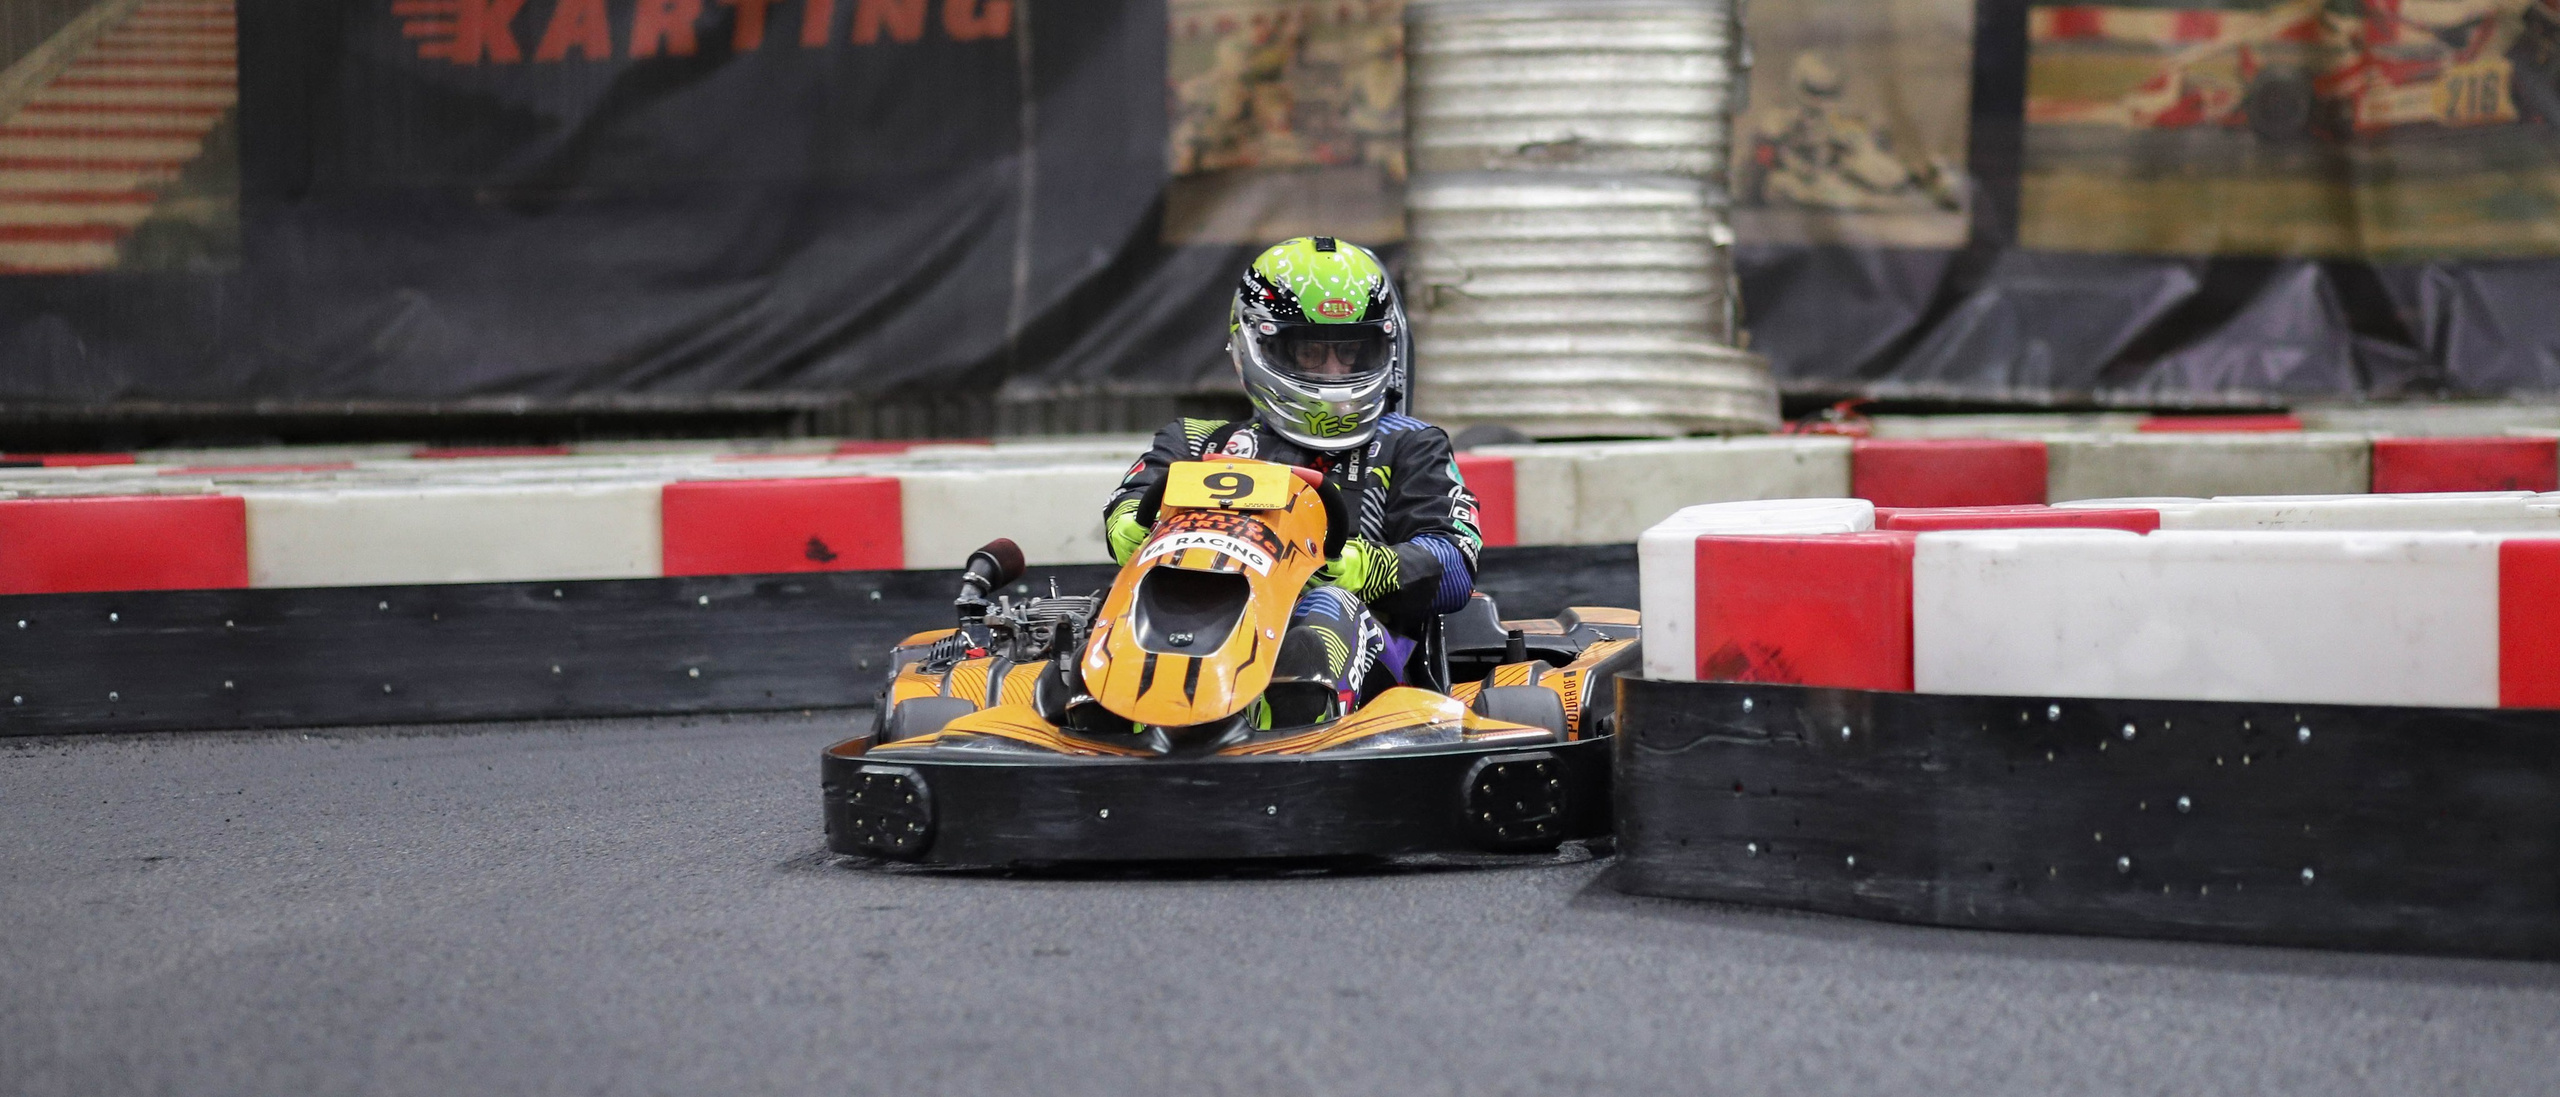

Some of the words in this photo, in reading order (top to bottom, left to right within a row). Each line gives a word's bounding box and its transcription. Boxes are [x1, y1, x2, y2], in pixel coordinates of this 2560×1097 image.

[410, 0, 1013, 64] KARTING
[1323, 303, 1349, 312] BELL
[1305, 411, 1359, 438] YES
[1203, 472, 1255, 500] 9
[1168, 512, 1264, 533] ONATO
[1159, 520, 1277, 554] KARTING
[1176, 537, 1264, 566] RACING
[1563, 680, 1577, 690] OF
[1564, 690, 1579, 733] POWER
